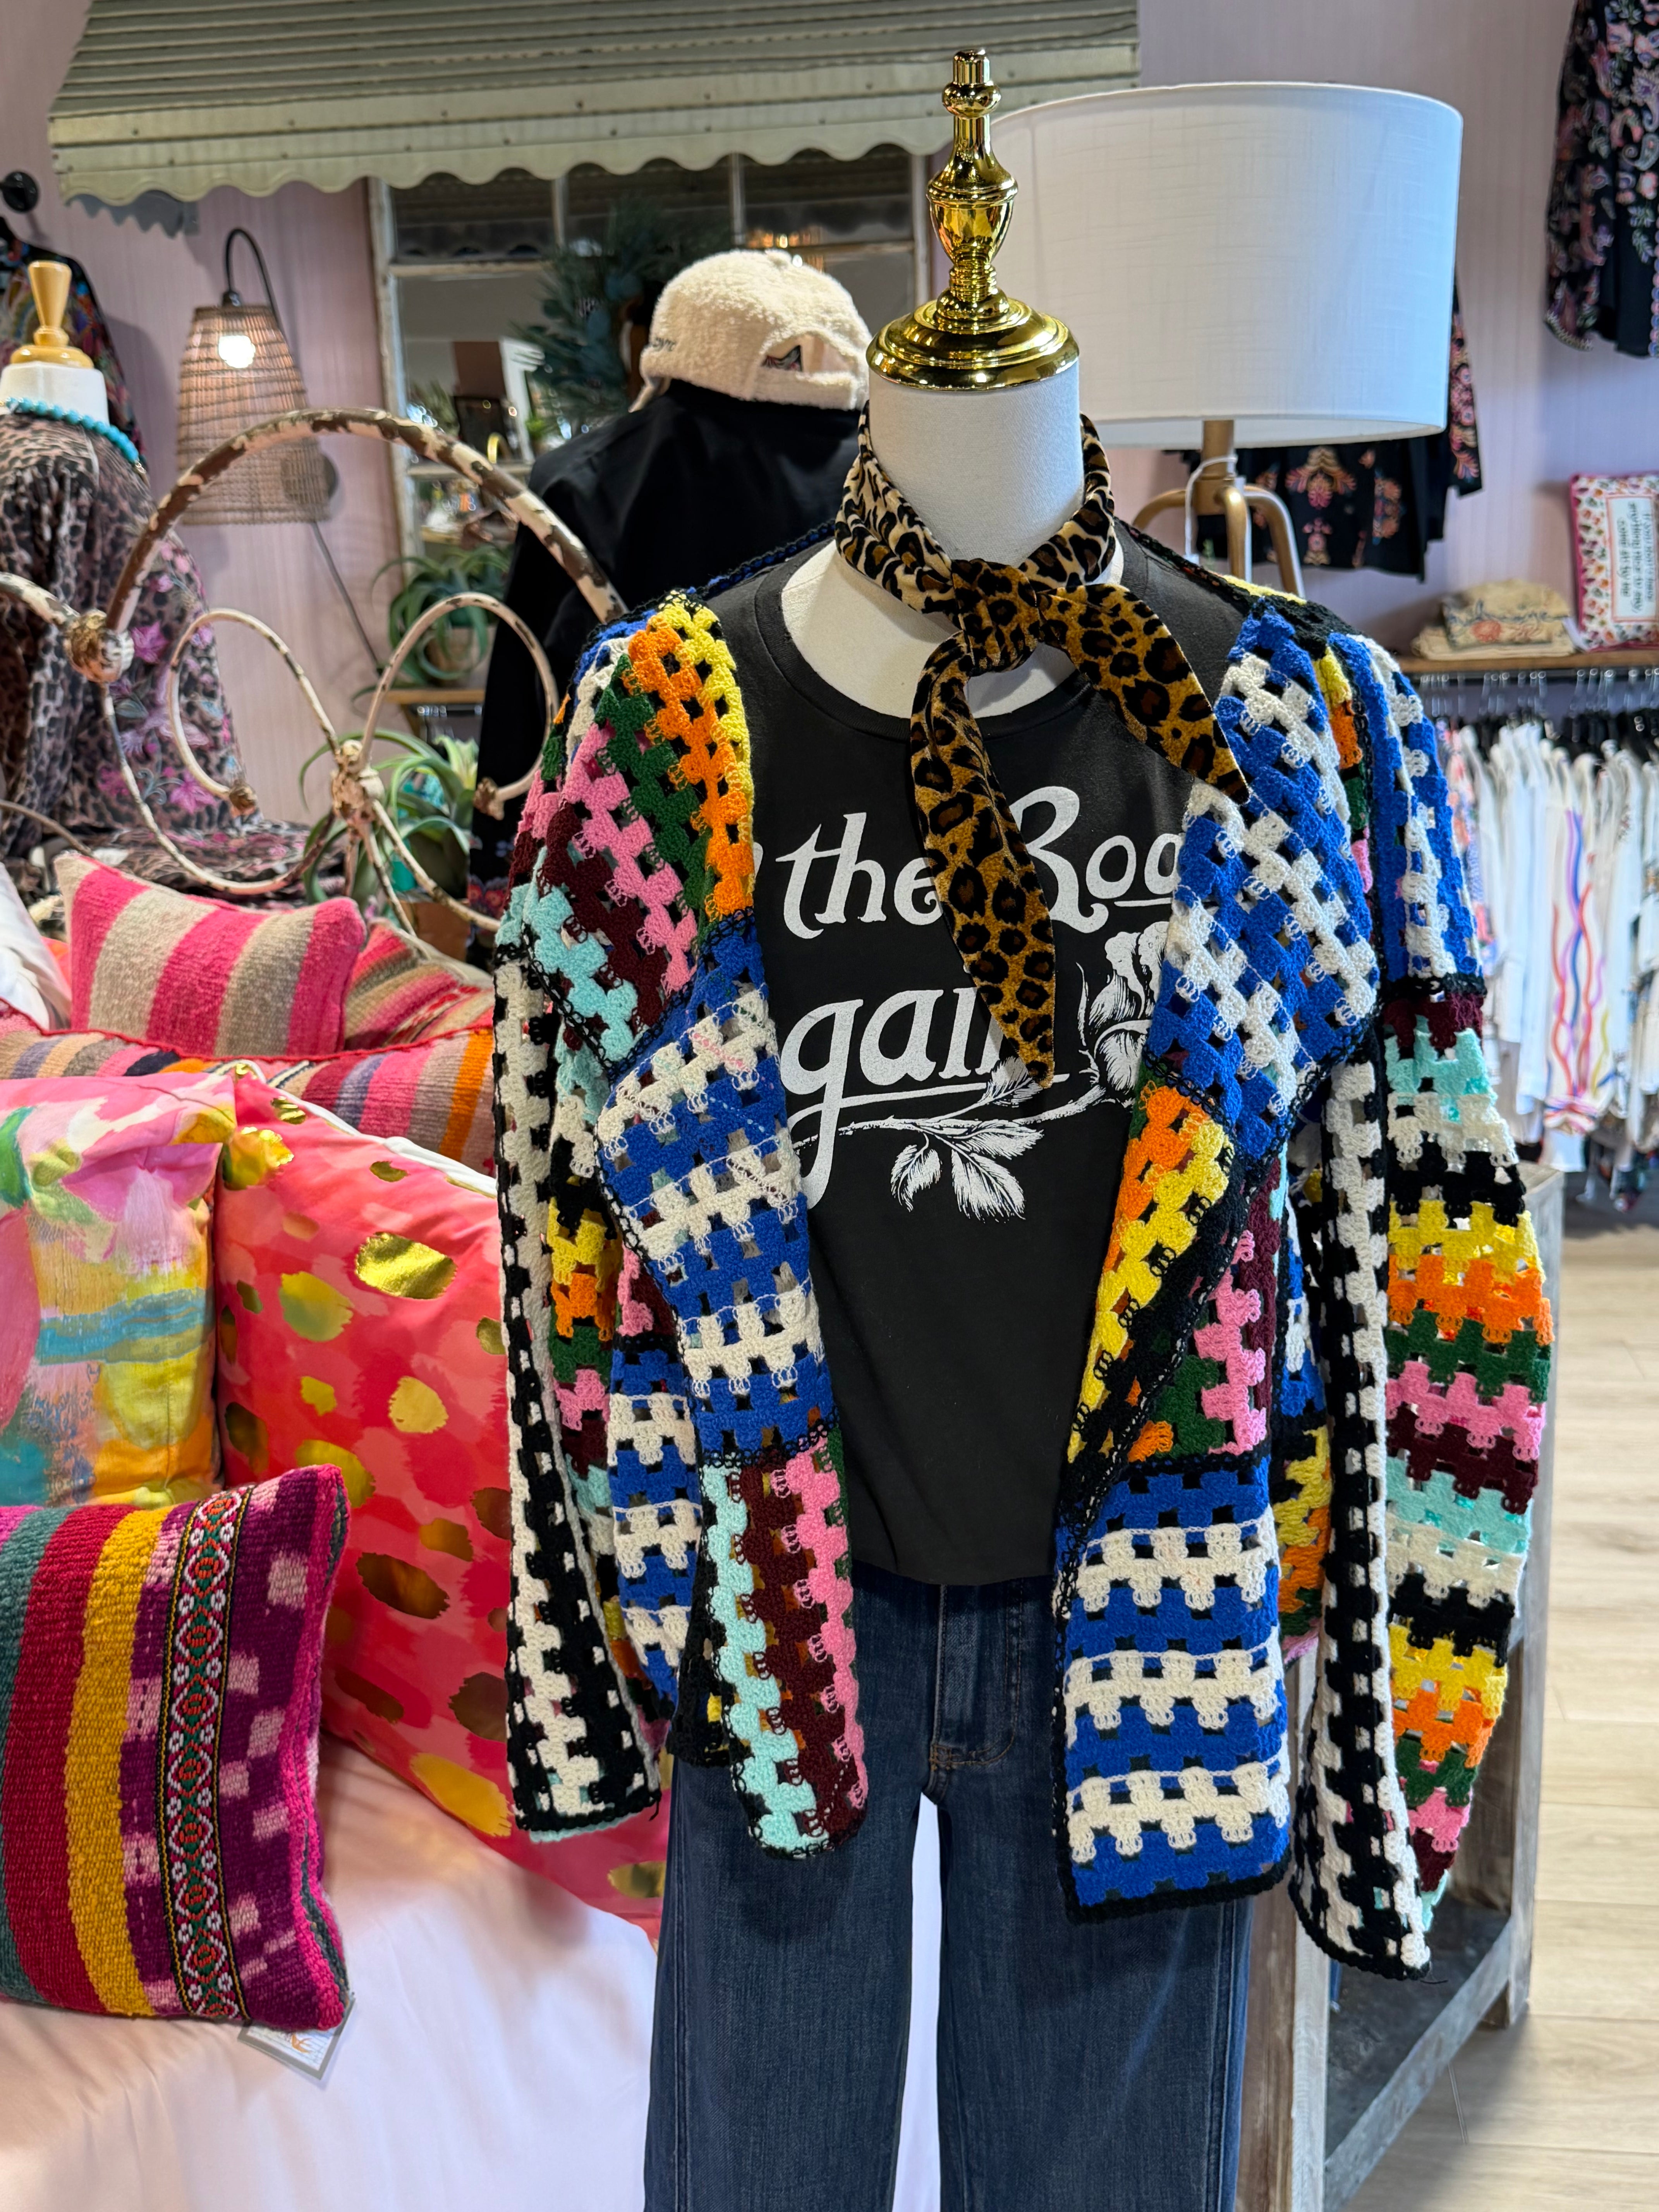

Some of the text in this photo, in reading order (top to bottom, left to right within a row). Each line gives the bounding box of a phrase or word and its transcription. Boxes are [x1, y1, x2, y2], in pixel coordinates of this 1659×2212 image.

[775, 786, 1184, 939] the Roa
[780, 964, 1004, 1210] gai
